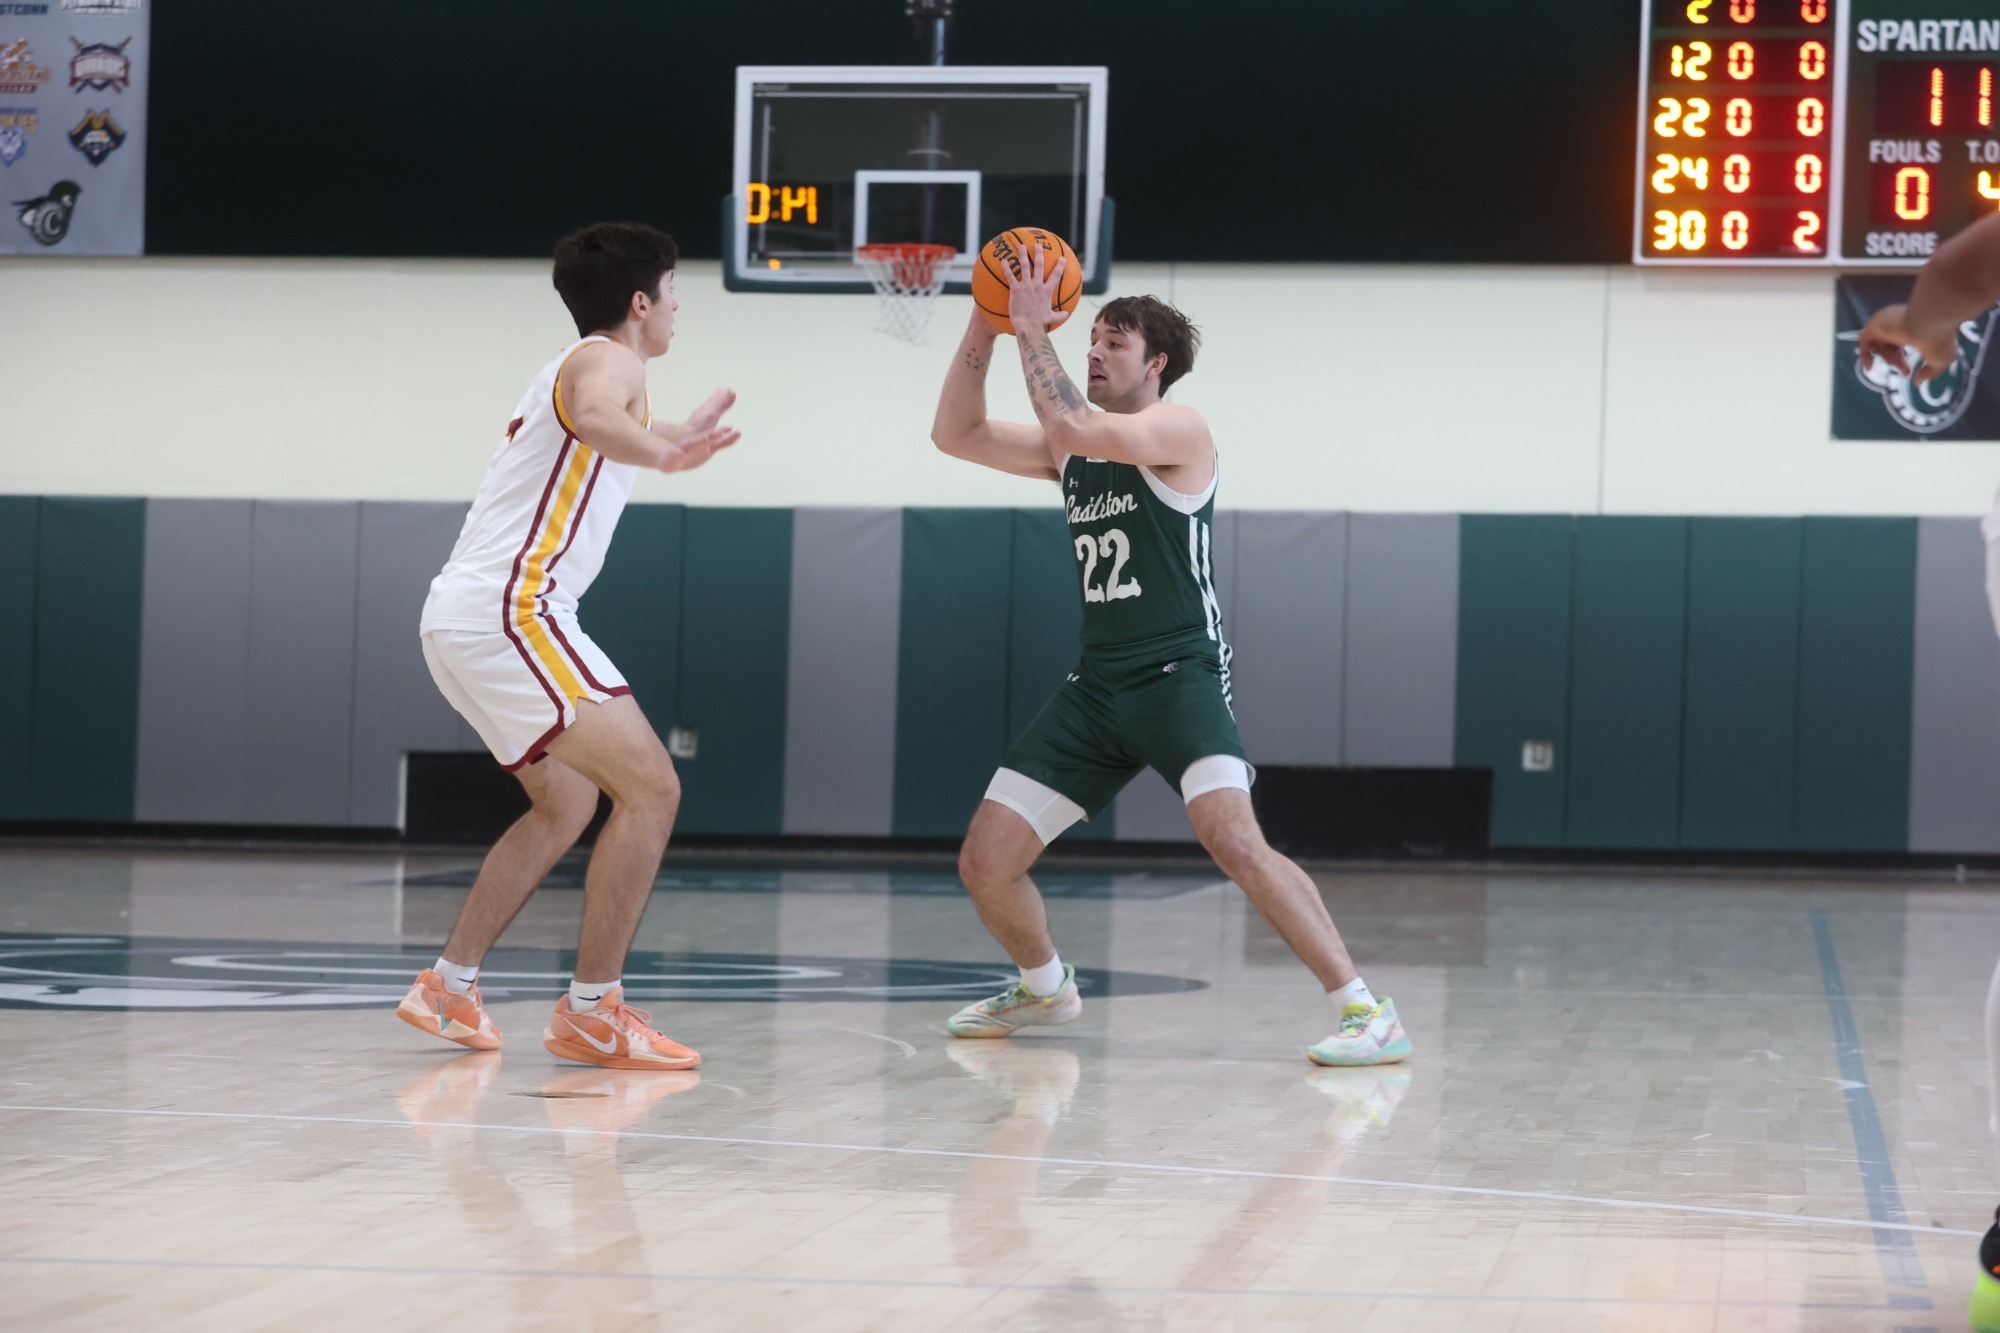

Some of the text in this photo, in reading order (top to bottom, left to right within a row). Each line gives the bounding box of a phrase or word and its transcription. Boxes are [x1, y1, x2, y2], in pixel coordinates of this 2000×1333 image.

[1857, 19, 2000, 52] SPARTAN
[1671, 41, 1825, 81] 12 0 0
[1929, 67, 1991, 126] 11
[1653, 98, 1824, 138] 22 0 0
[1869, 140, 1942, 164] FOULS
[1652, 153, 1822, 194] 24 0 0
[1894, 166, 1930, 220] 0
[1653, 210, 1820, 251] 30 0 2
[1866, 232, 1938, 256] SCORE
[1074, 528, 1142, 603] 22
